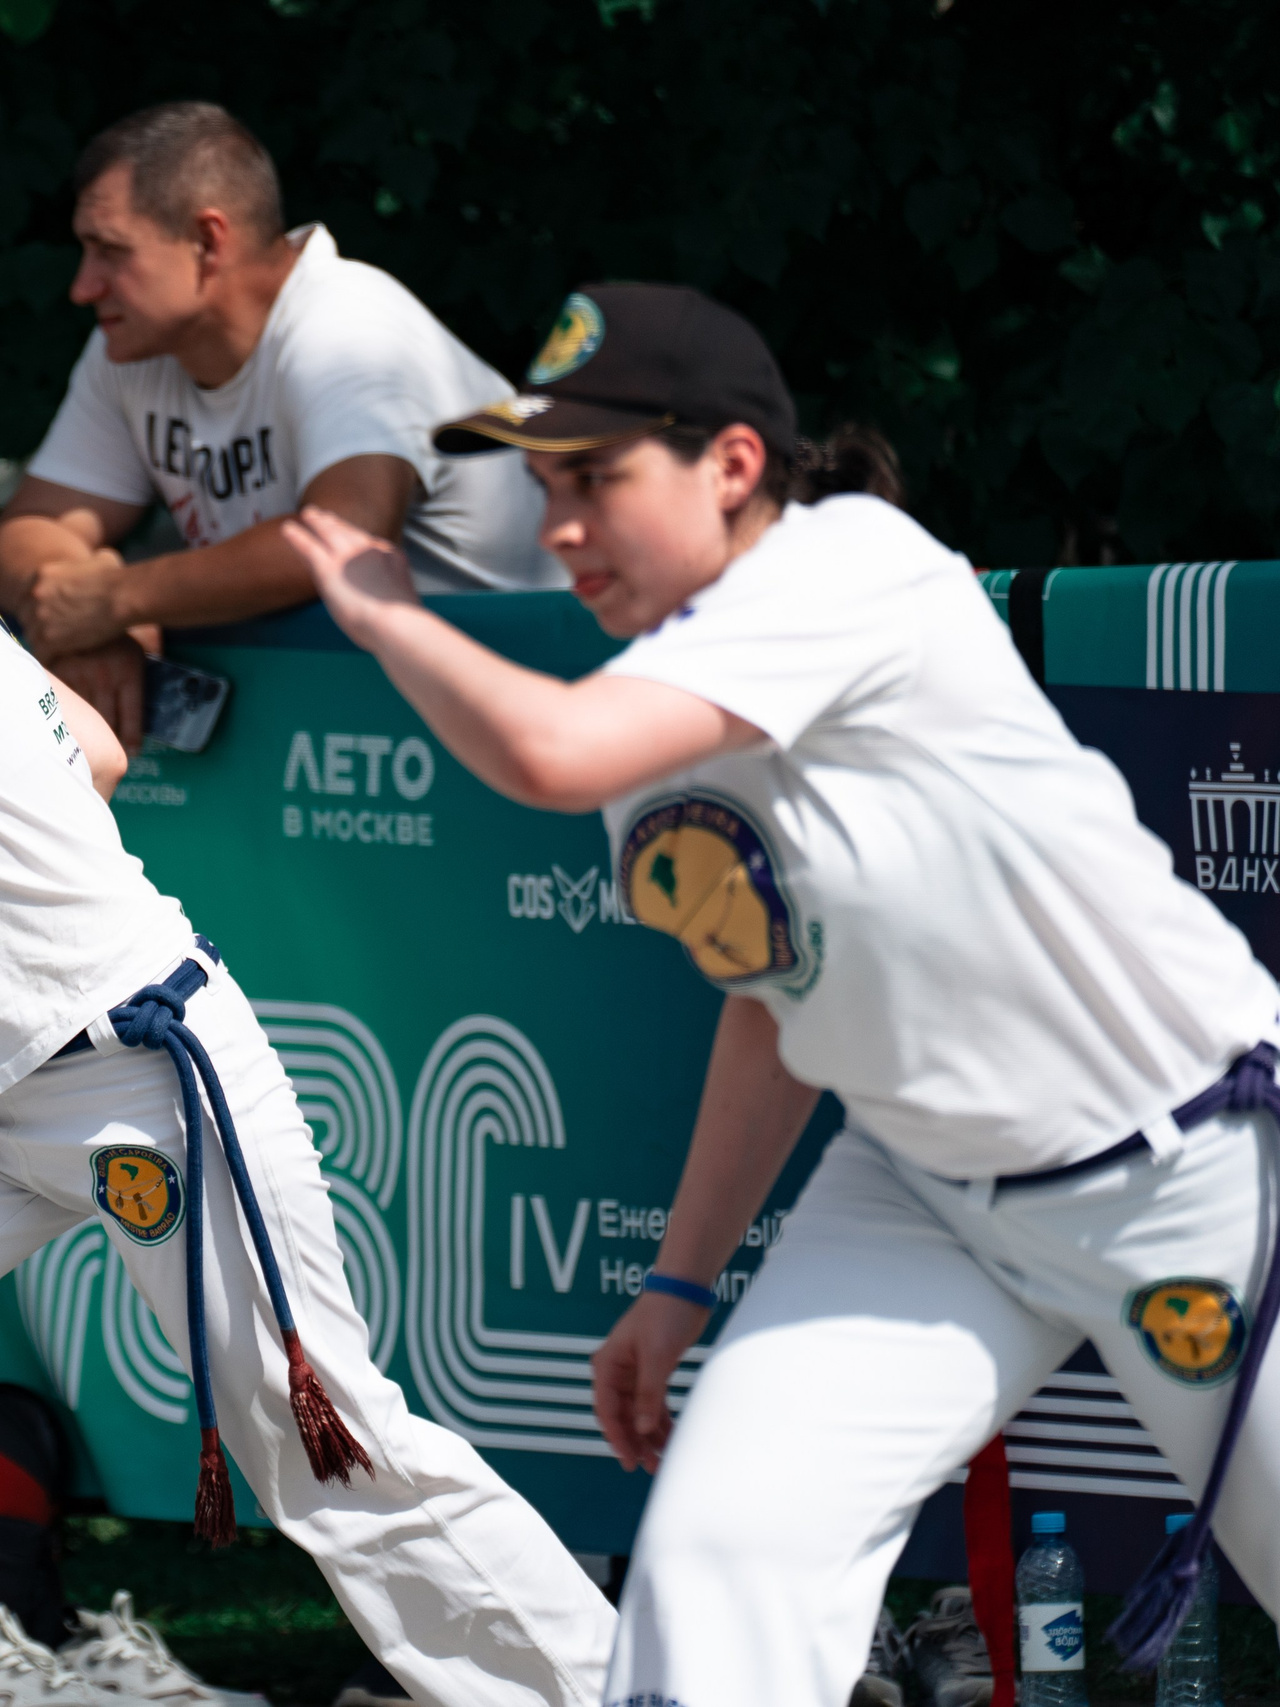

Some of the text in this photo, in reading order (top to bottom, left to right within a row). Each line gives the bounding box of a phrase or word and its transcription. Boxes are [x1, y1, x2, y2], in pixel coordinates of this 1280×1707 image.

[284, 731, 434, 801] ЛЕТО
[282, 805, 434, 847] В МОСКВЕ
[1195, 854, 1280, 894] ВДНХ
[119, 1149, 168, 1171] CAPOEIRA
[509, 1192, 592, 1294] IV
